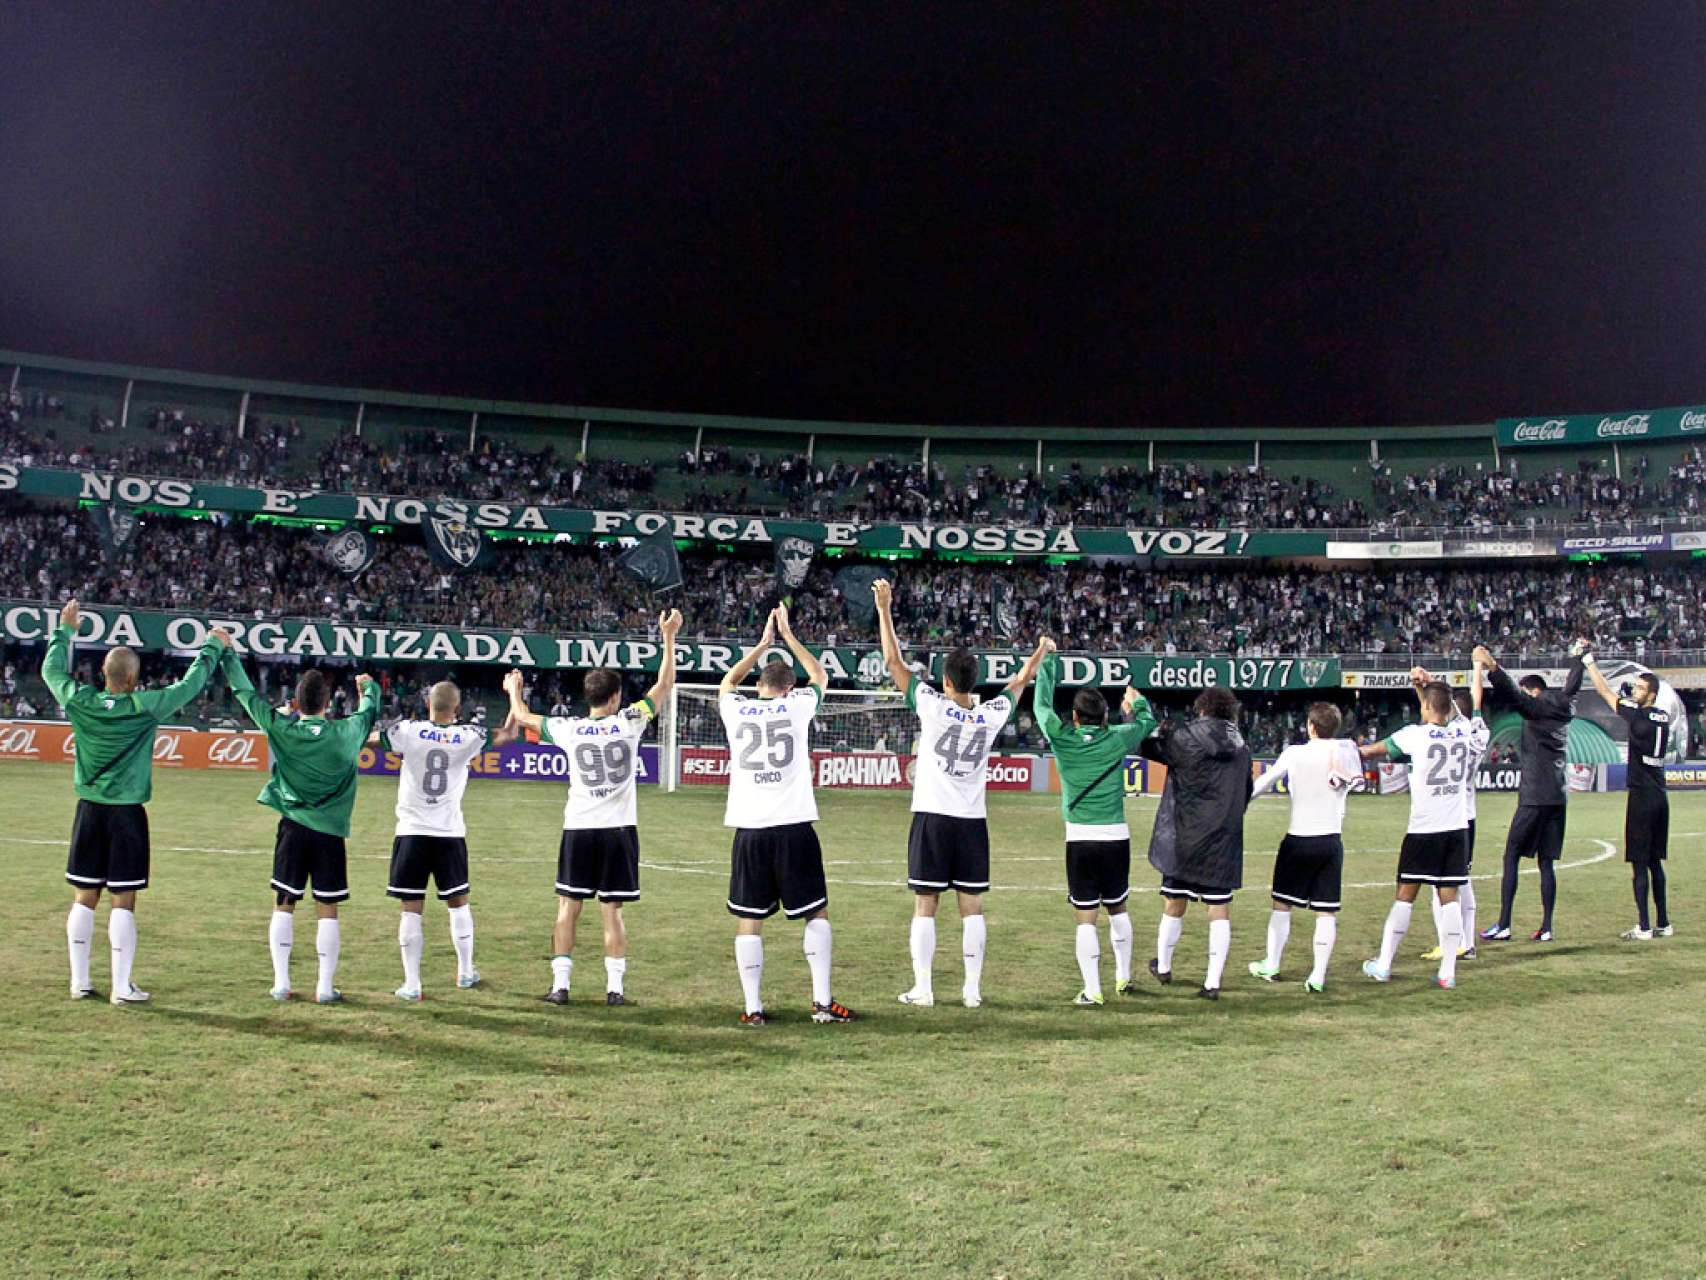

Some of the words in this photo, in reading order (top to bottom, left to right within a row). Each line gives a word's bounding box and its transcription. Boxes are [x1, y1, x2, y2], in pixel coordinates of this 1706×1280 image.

[1514, 420, 1568, 441] Coca-Cola
[1597, 414, 1650, 437] Coca-Cola
[900, 524, 1080, 553] NOSSA
[1128, 529, 1250, 555] VOZ!
[166, 617, 536, 666] ORGANIZADA
[1150, 660, 1217, 688] desde
[1229, 660, 1294, 688] 1977
[208, 737, 259, 763] GOL
[736, 719, 794, 771] 25
[935, 724, 987, 771] 44
[1653, 726, 1662, 758] 1
[423, 748, 448, 796] 8
[575, 740, 631, 786] 99
[754, 771, 782, 784] CHICO
[819, 756, 901, 786] BRAHMA
[1426, 742, 1467, 785] 23
